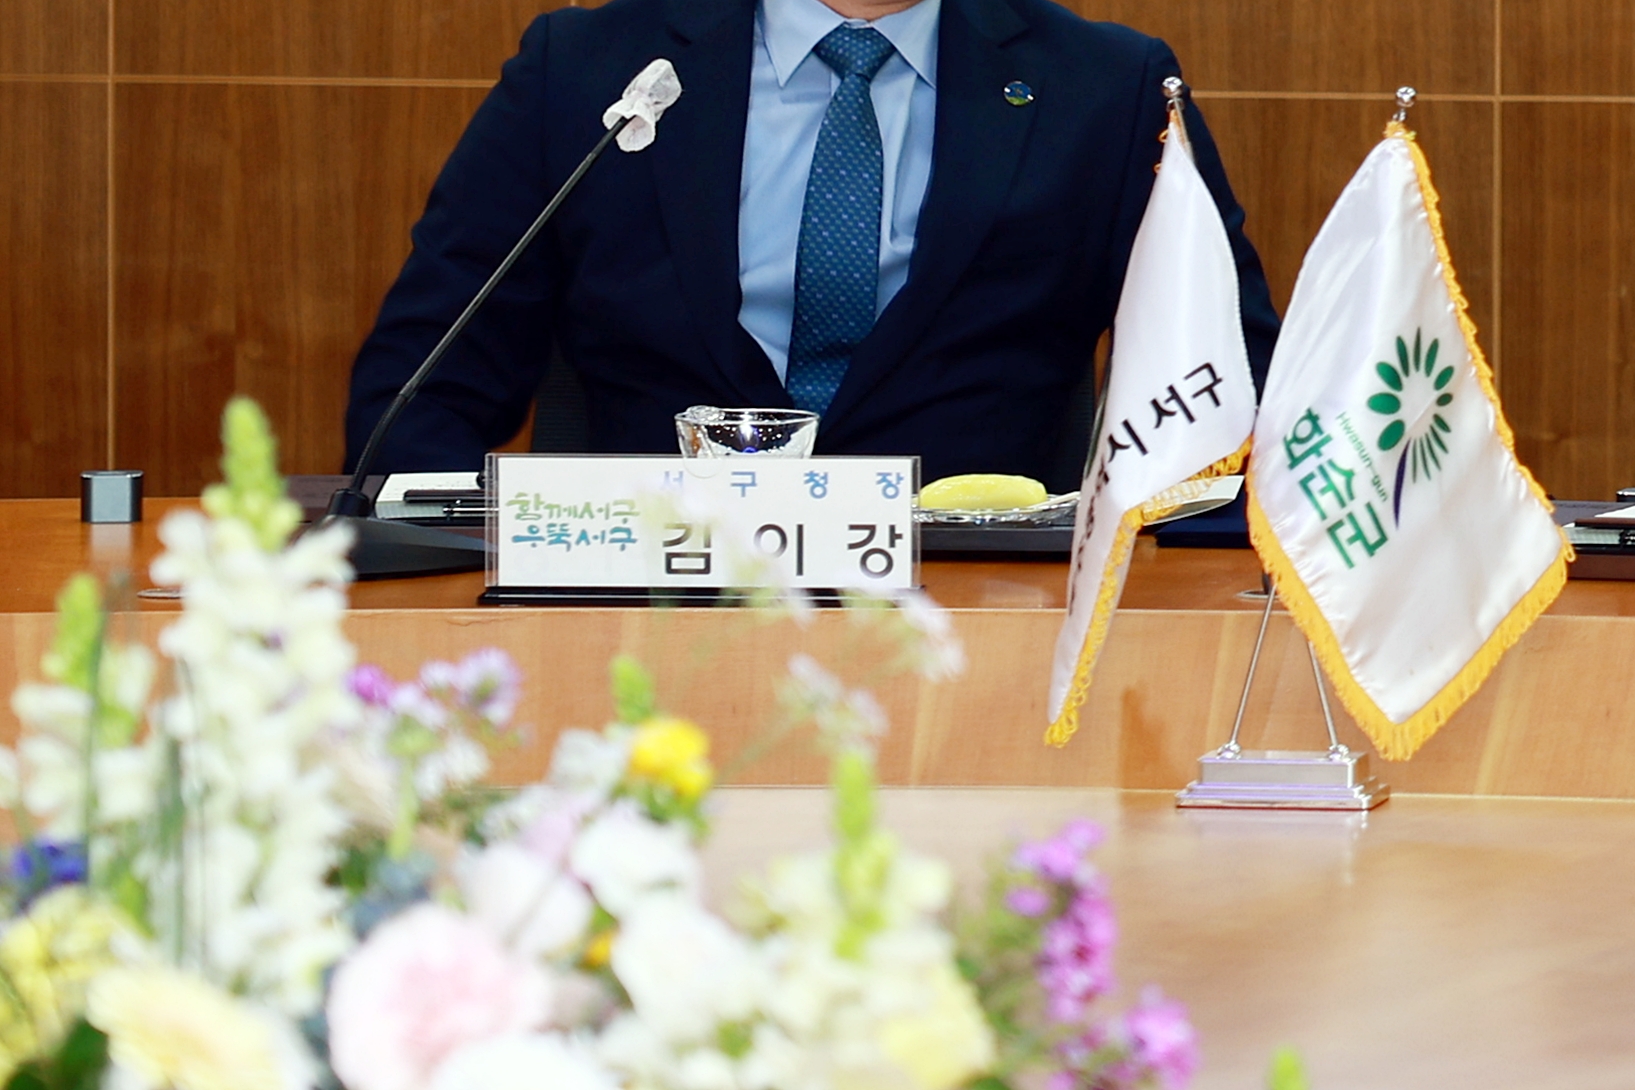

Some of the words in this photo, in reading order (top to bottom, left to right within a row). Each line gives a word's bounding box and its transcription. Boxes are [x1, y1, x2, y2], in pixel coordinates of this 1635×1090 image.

[1147, 362, 1222, 429] 서구
[1283, 407, 1389, 570] 화순군
[1335, 410, 1389, 503] Hwasun-gun
